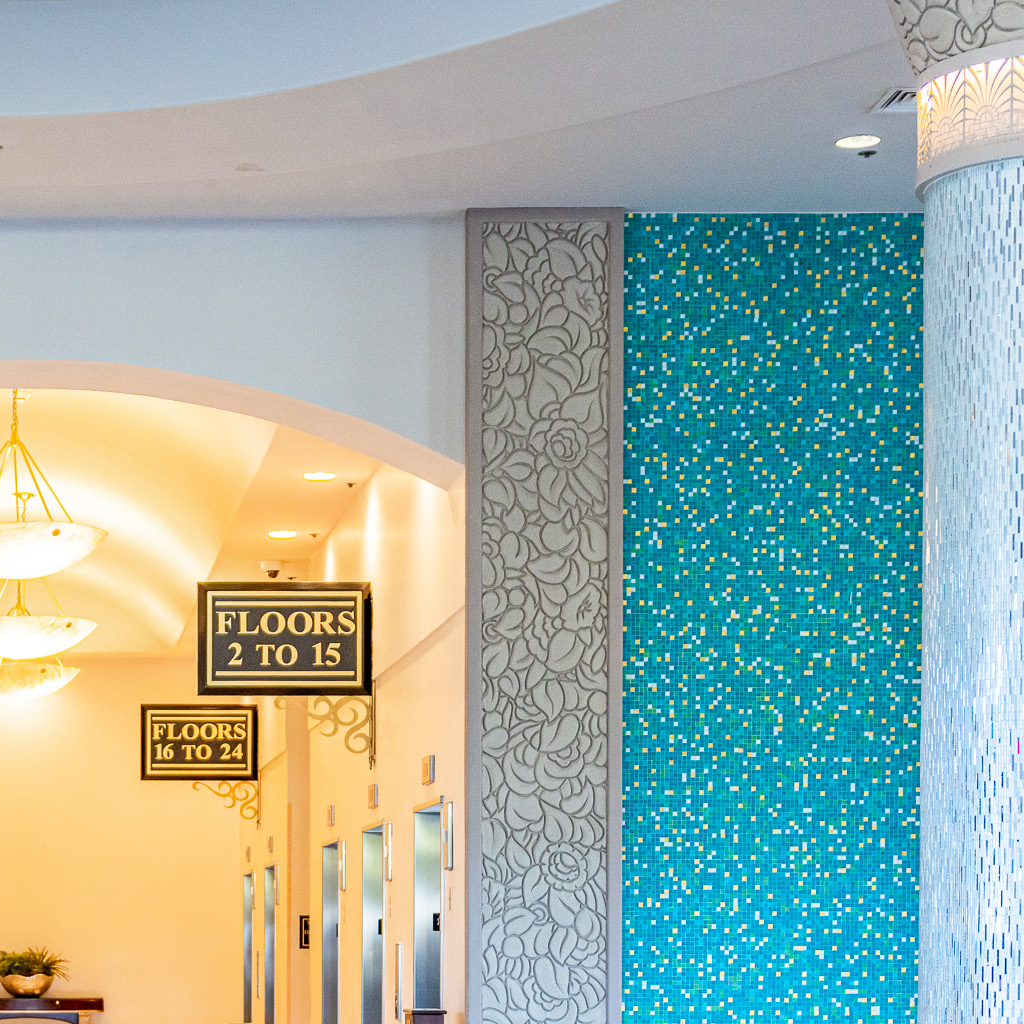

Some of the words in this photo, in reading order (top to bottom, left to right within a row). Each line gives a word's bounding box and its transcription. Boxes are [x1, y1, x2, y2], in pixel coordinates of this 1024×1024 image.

[215, 610, 356, 635] FLOORS
[227, 642, 243, 666] 2
[255, 644, 299, 666] TO
[311, 642, 342, 666] 15
[152, 723, 247, 740] FLOORS
[154, 743, 174, 760] 16
[181, 744, 212, 760] TO
[219, 743, 244, 760] 24
